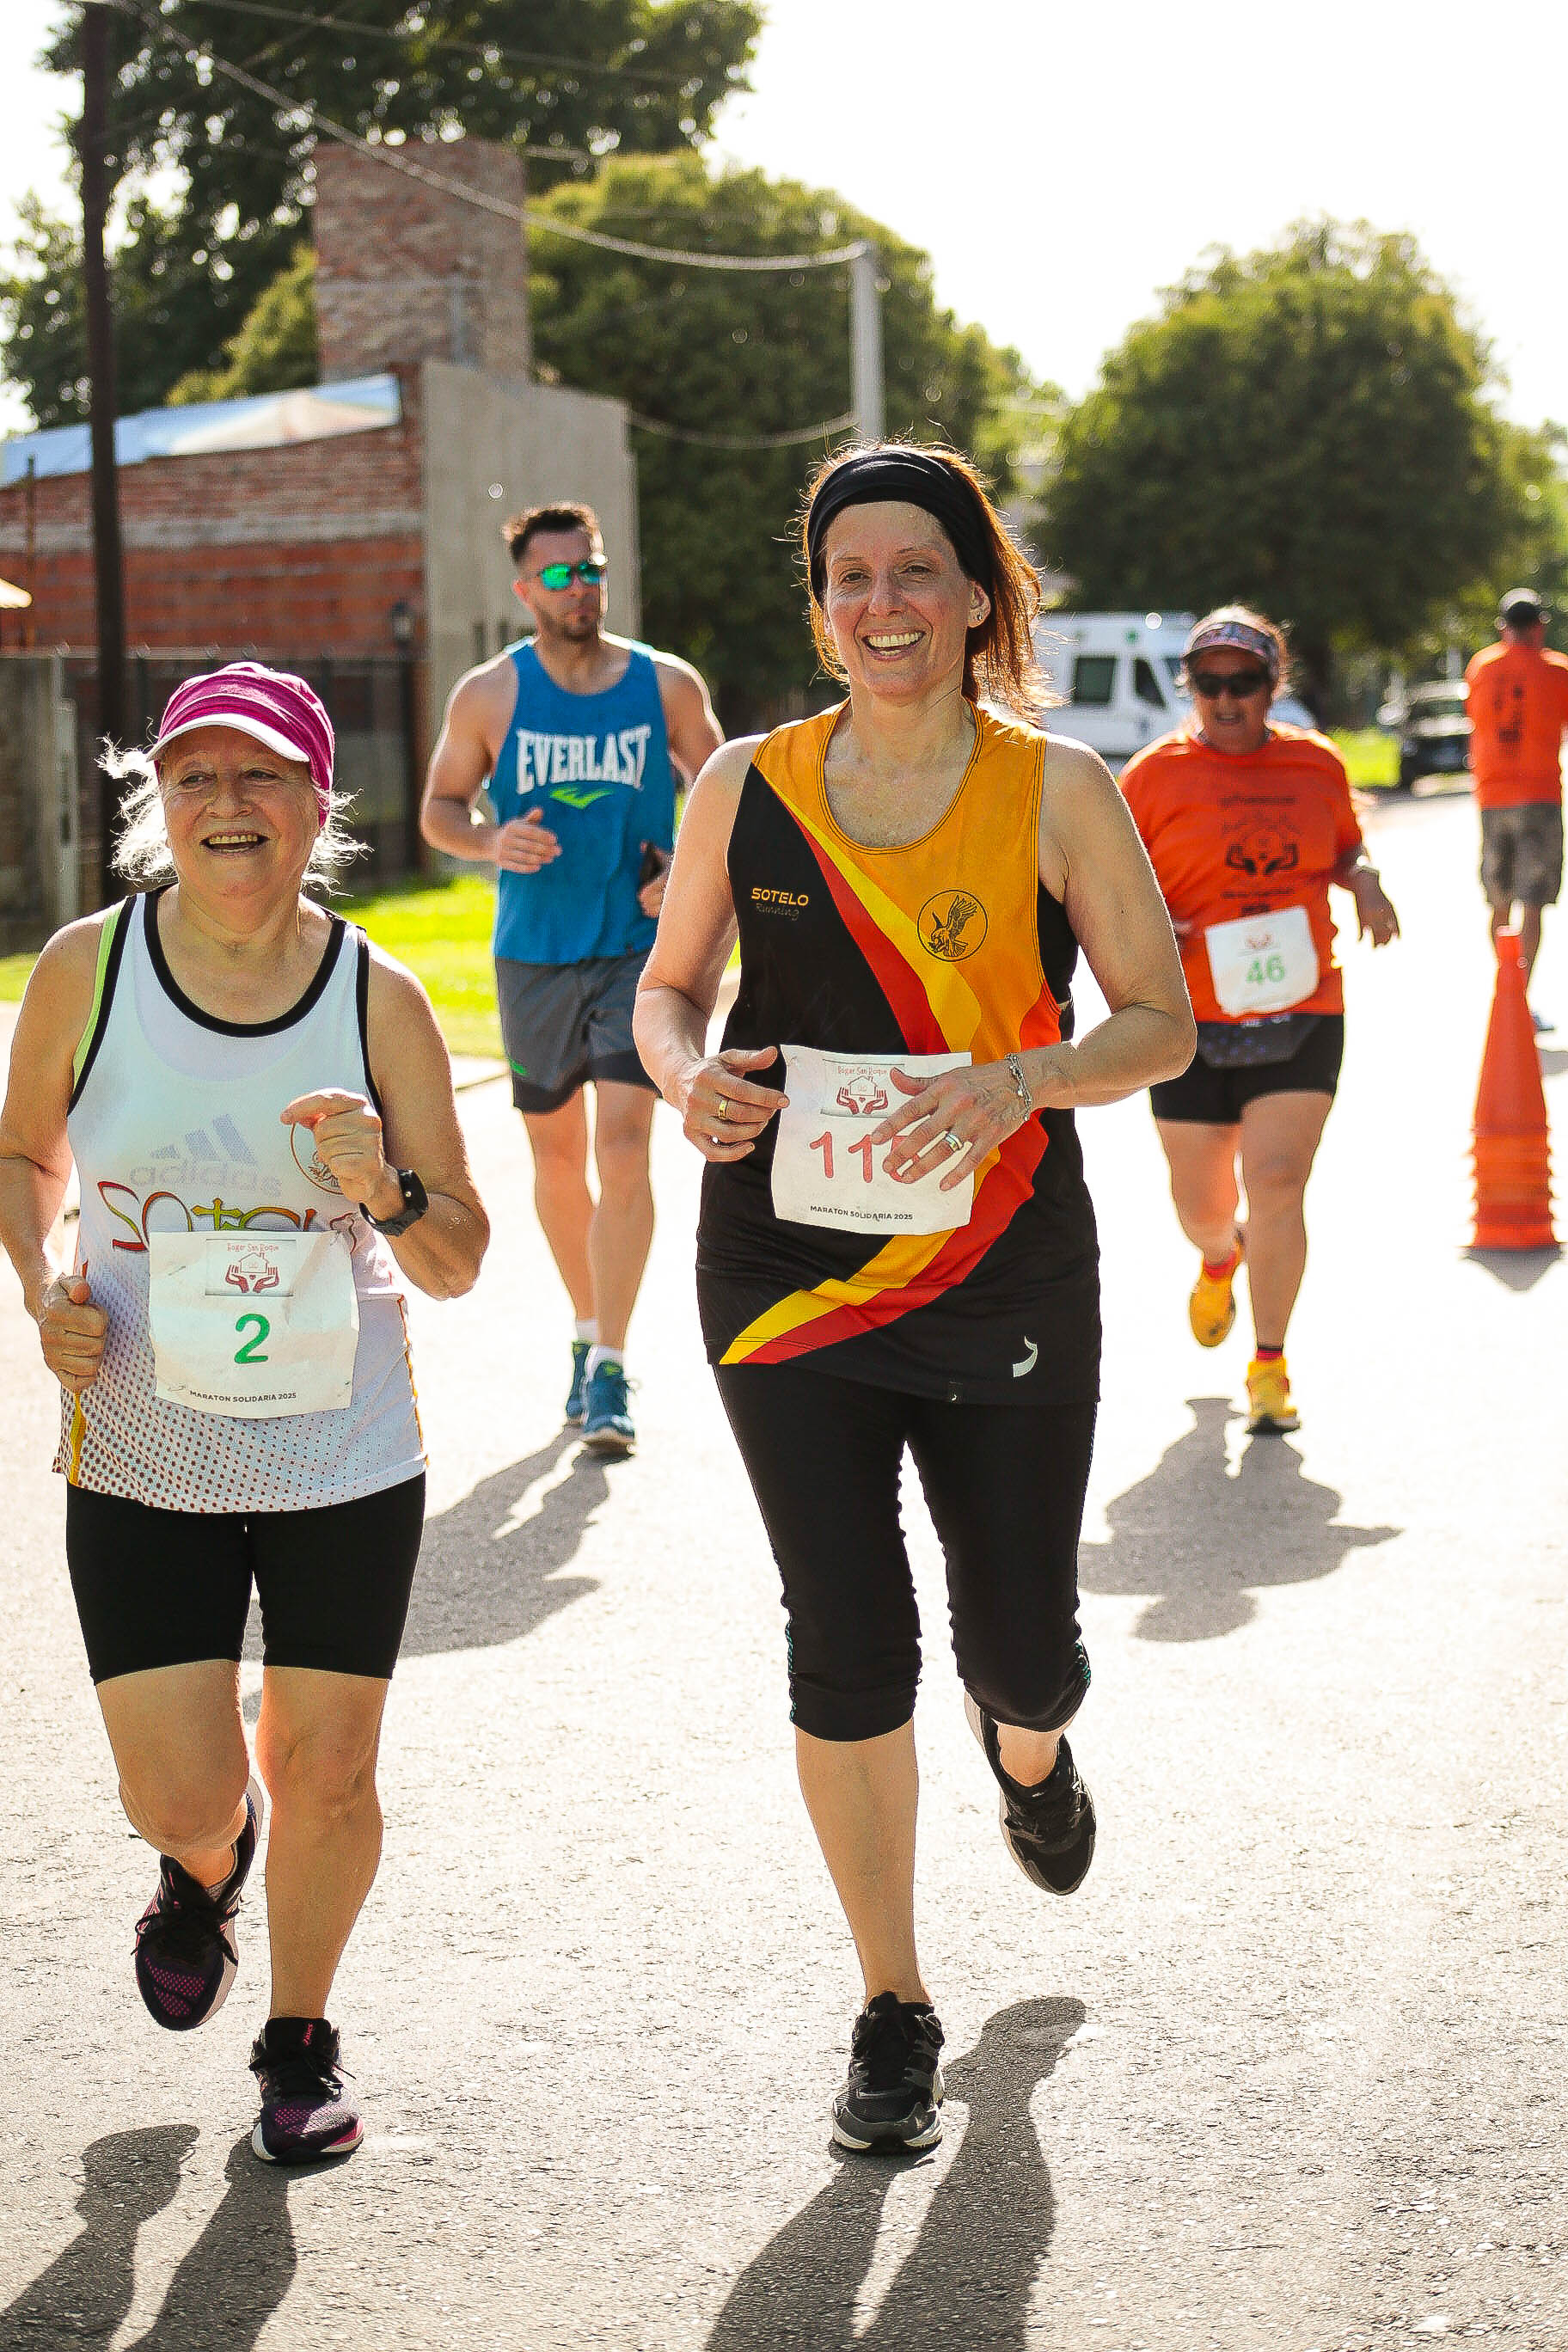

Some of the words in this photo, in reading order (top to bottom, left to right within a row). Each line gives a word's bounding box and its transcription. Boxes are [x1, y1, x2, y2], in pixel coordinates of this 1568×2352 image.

[516, 724, 651, 794] EVERLAST
[750, 887, 809, 907] SOTELO
[1246, 955, 1286, 983] 46
[129, 1158, 282, 1197] adidas
[810, 1204, 848, 1216] MARATON
[850, 1210, 892, 1221] SOLIDARIA
[234, 1314, 270, 1363] 2
[189, 1390, 231, 1401] MARATON
[232, 1393, 276, 1403] SOLIDARIA
[278, 1392, 297, 1400] 2025
